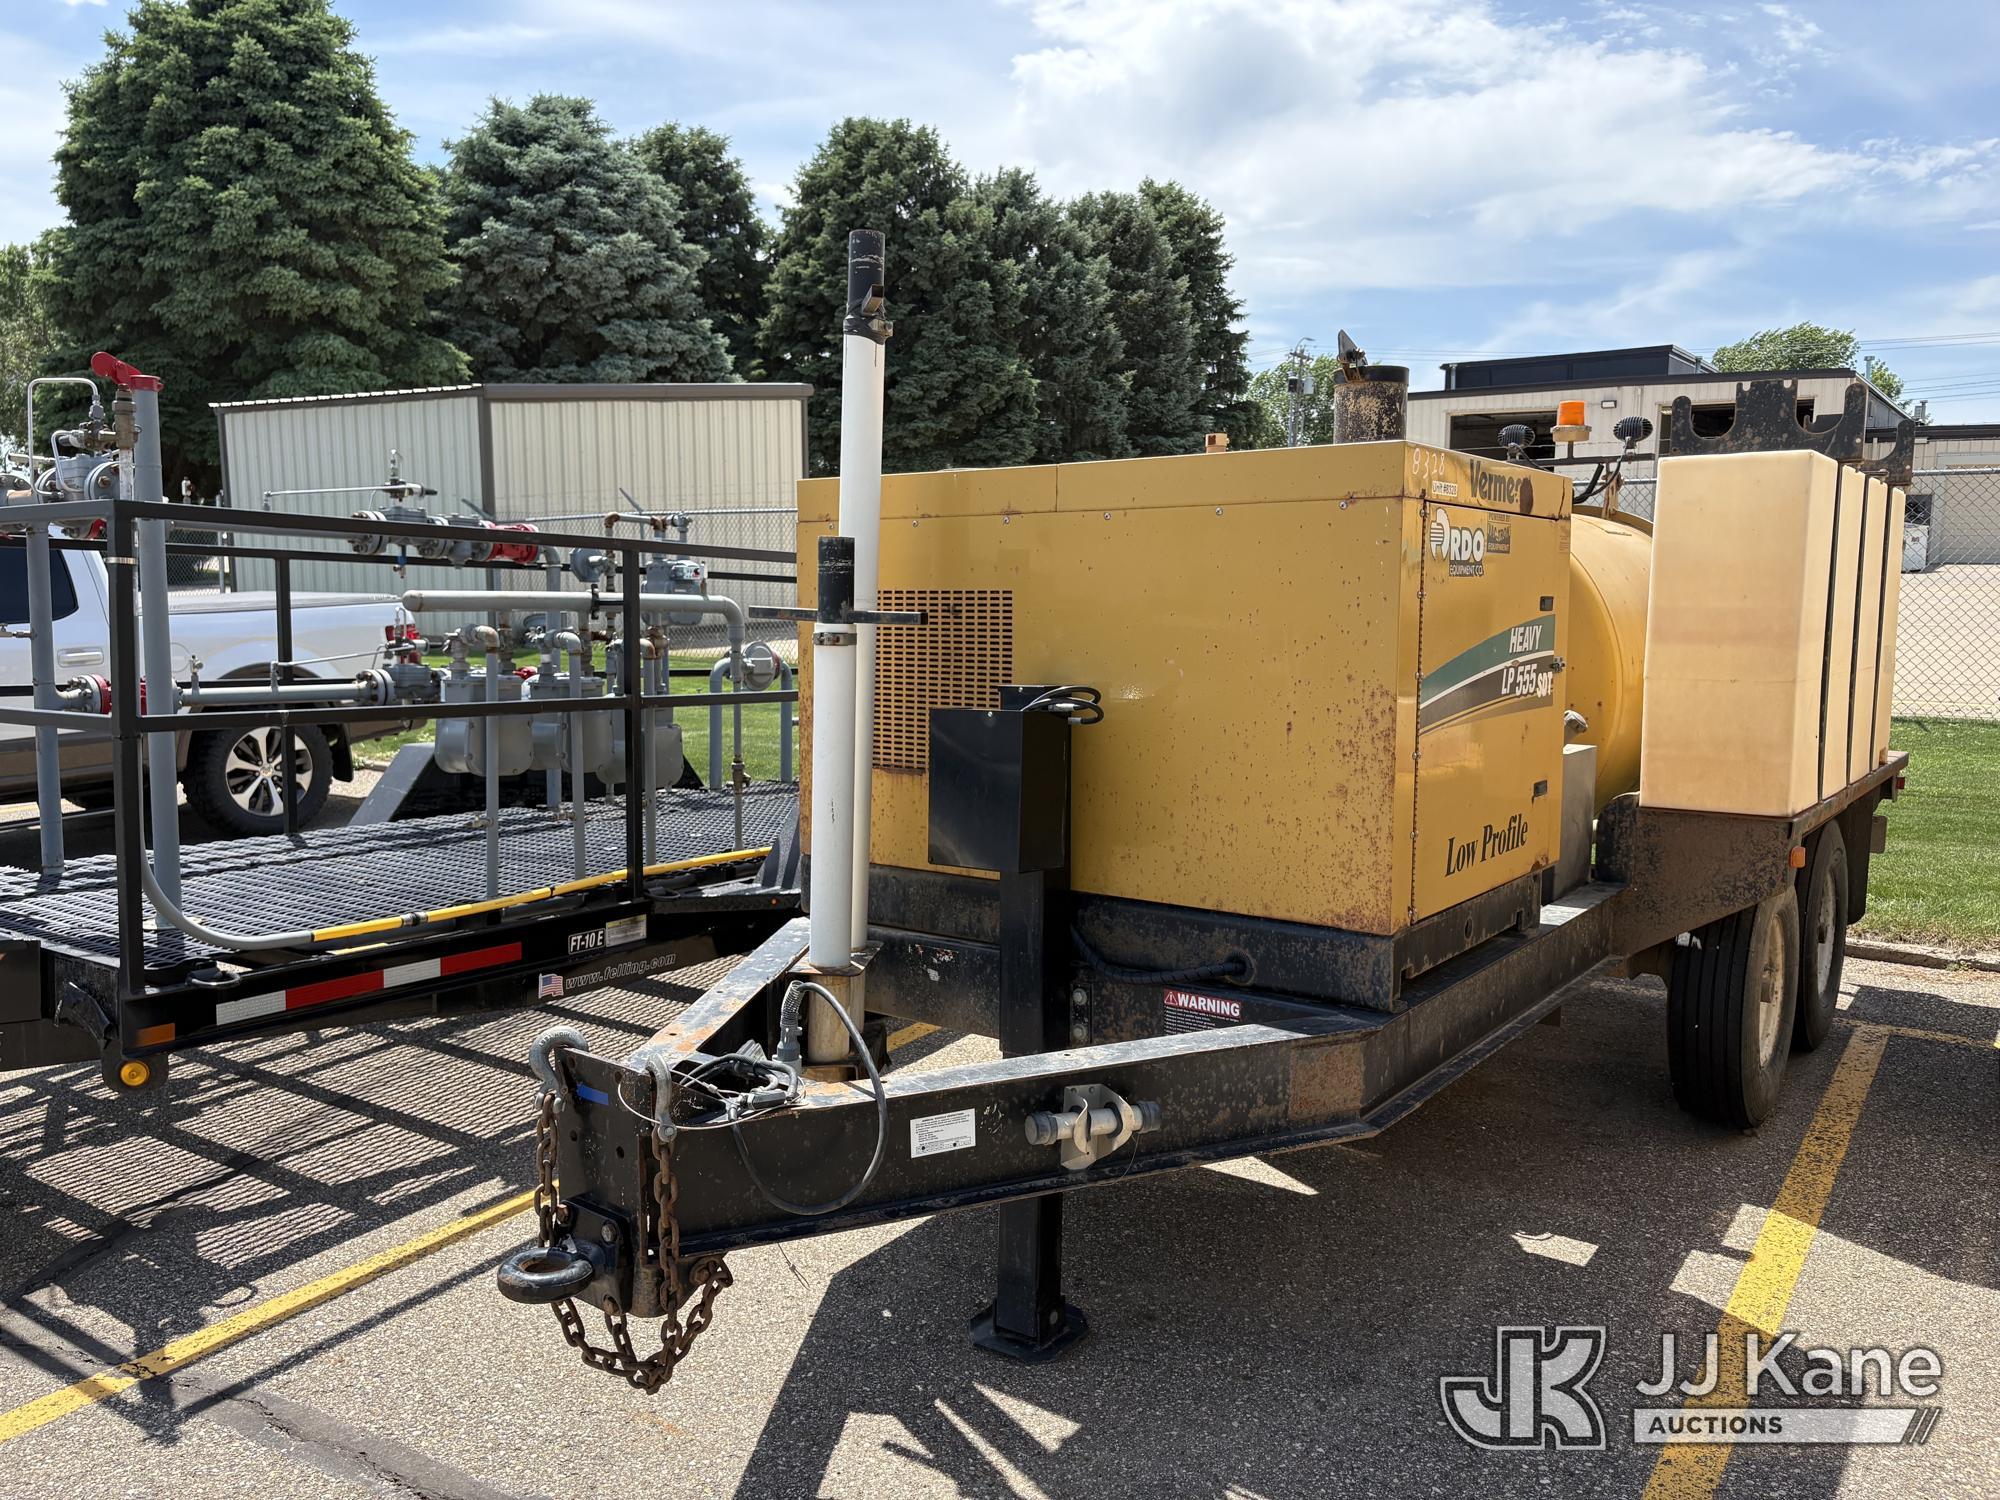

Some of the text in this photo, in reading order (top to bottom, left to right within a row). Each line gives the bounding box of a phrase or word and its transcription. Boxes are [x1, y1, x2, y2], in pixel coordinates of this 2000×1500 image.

[1413, 447, 1445, 479] 8328
[1469, 458, 1531, 505] Verme
[1449, 564, 1475, 576] EQUIPMENT
[1509, 625, 1542, 653] HEAVY
[1501, 663, 1553, 698] LP 555 SDT
[1445, 813, 1528, 877] Low Profile
[570, 932, 595, 952] FT-10
[597, 930, 604, 946] E
[565, 953, 676, 990] www.felling.com
[1177, 992, 1240, 1017] WARNING
